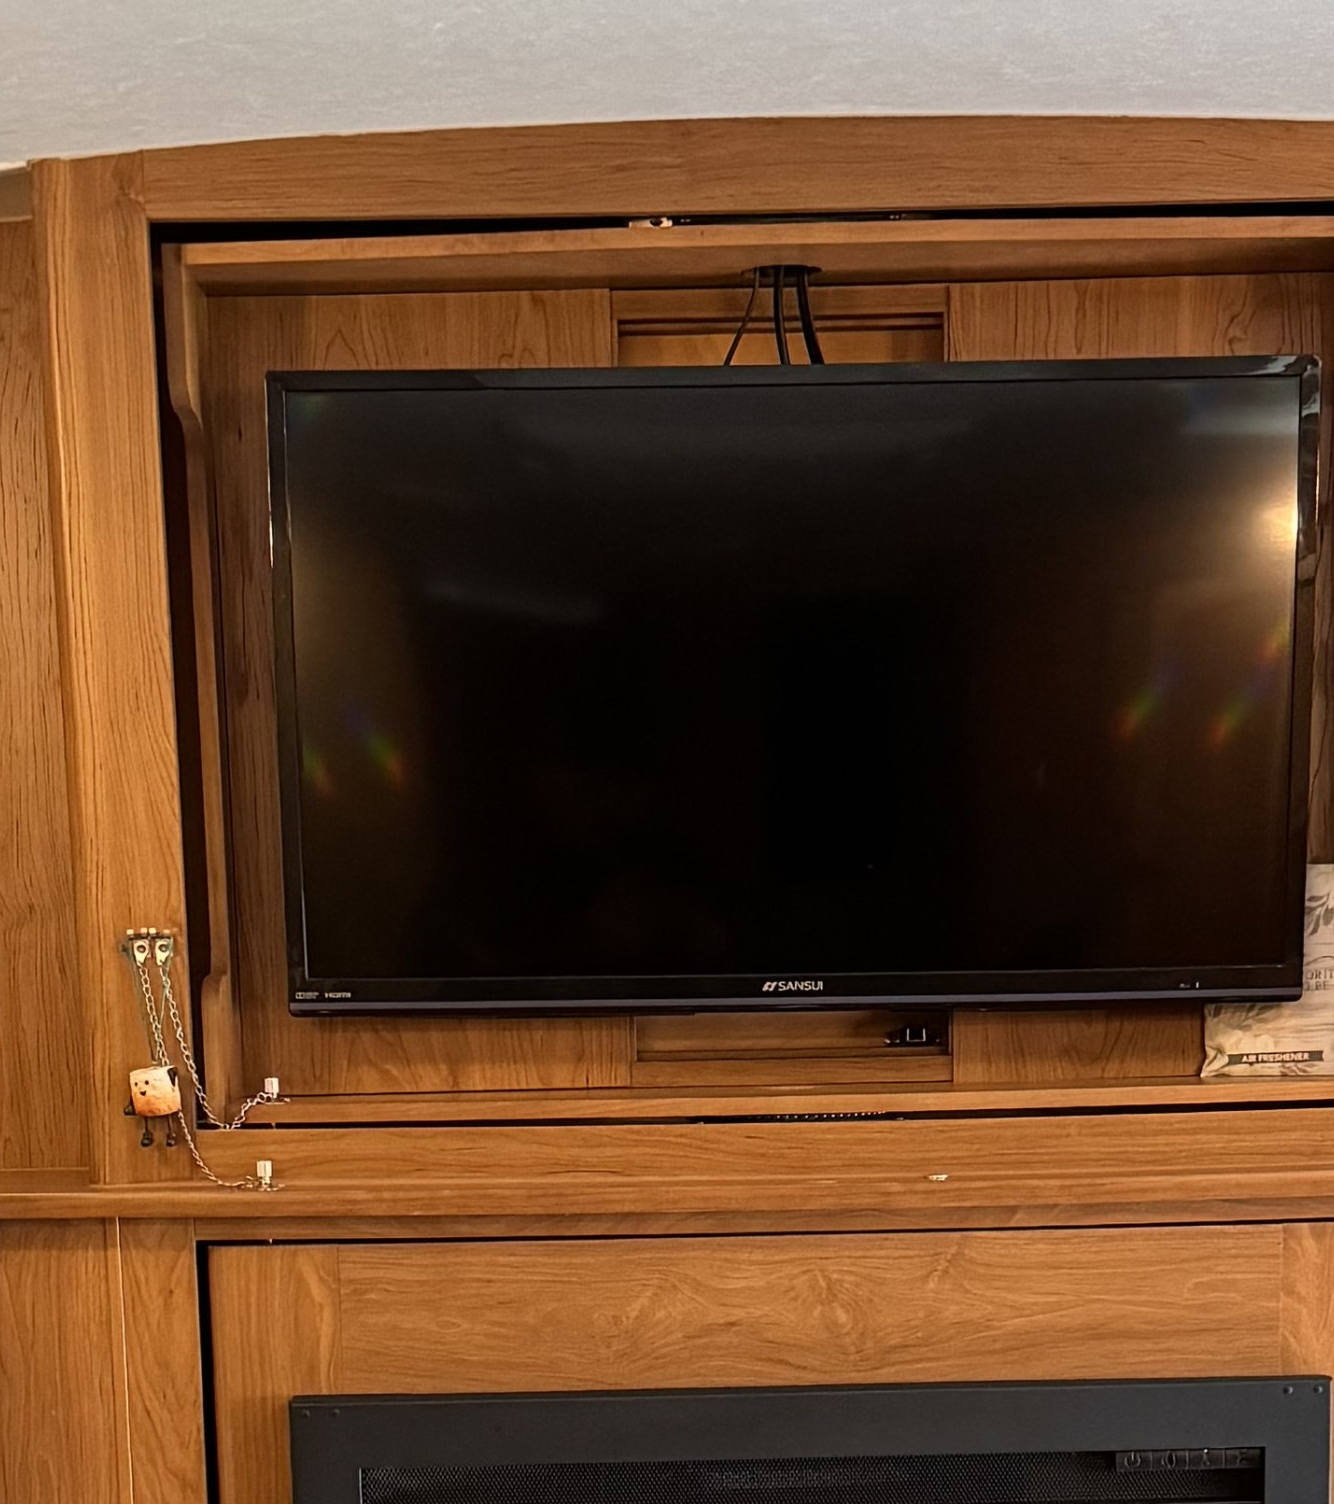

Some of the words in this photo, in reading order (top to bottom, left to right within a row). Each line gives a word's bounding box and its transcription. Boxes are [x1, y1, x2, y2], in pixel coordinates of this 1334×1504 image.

[778, 980, 824, 992] SANSUI
[1241, 1054, 1257, 1063] AIR
[1258, 1052, 1310, 1063] FRESHENER
